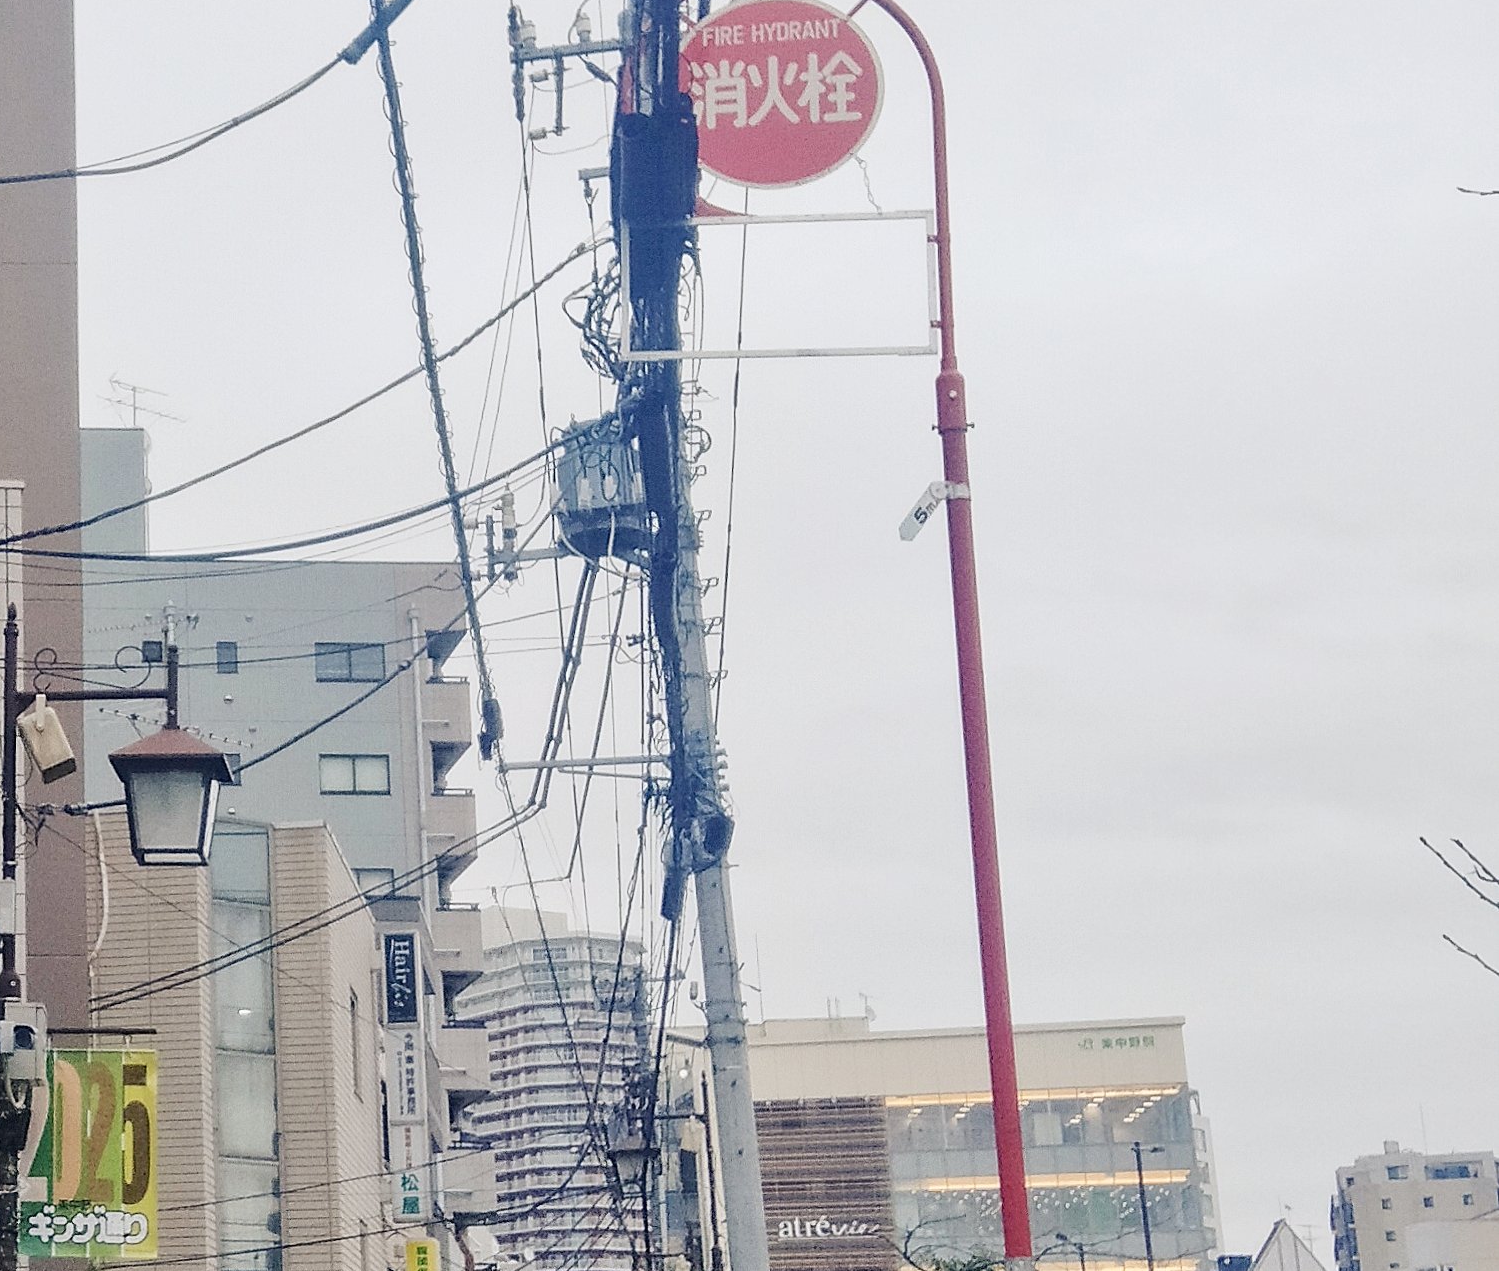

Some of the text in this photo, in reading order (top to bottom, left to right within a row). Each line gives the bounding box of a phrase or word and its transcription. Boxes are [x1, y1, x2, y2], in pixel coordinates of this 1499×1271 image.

[702, 18, 842, 47] FIRE HYDRANT
[689, 50, 863, 130] 消火栓
[394, 940, 411, 984] Hair
[18, 1060, 151, 1205] 2025
[401, 1172, 420, 1215] 松屋
[28, 1204, 149, 1244] ギンザ通り
